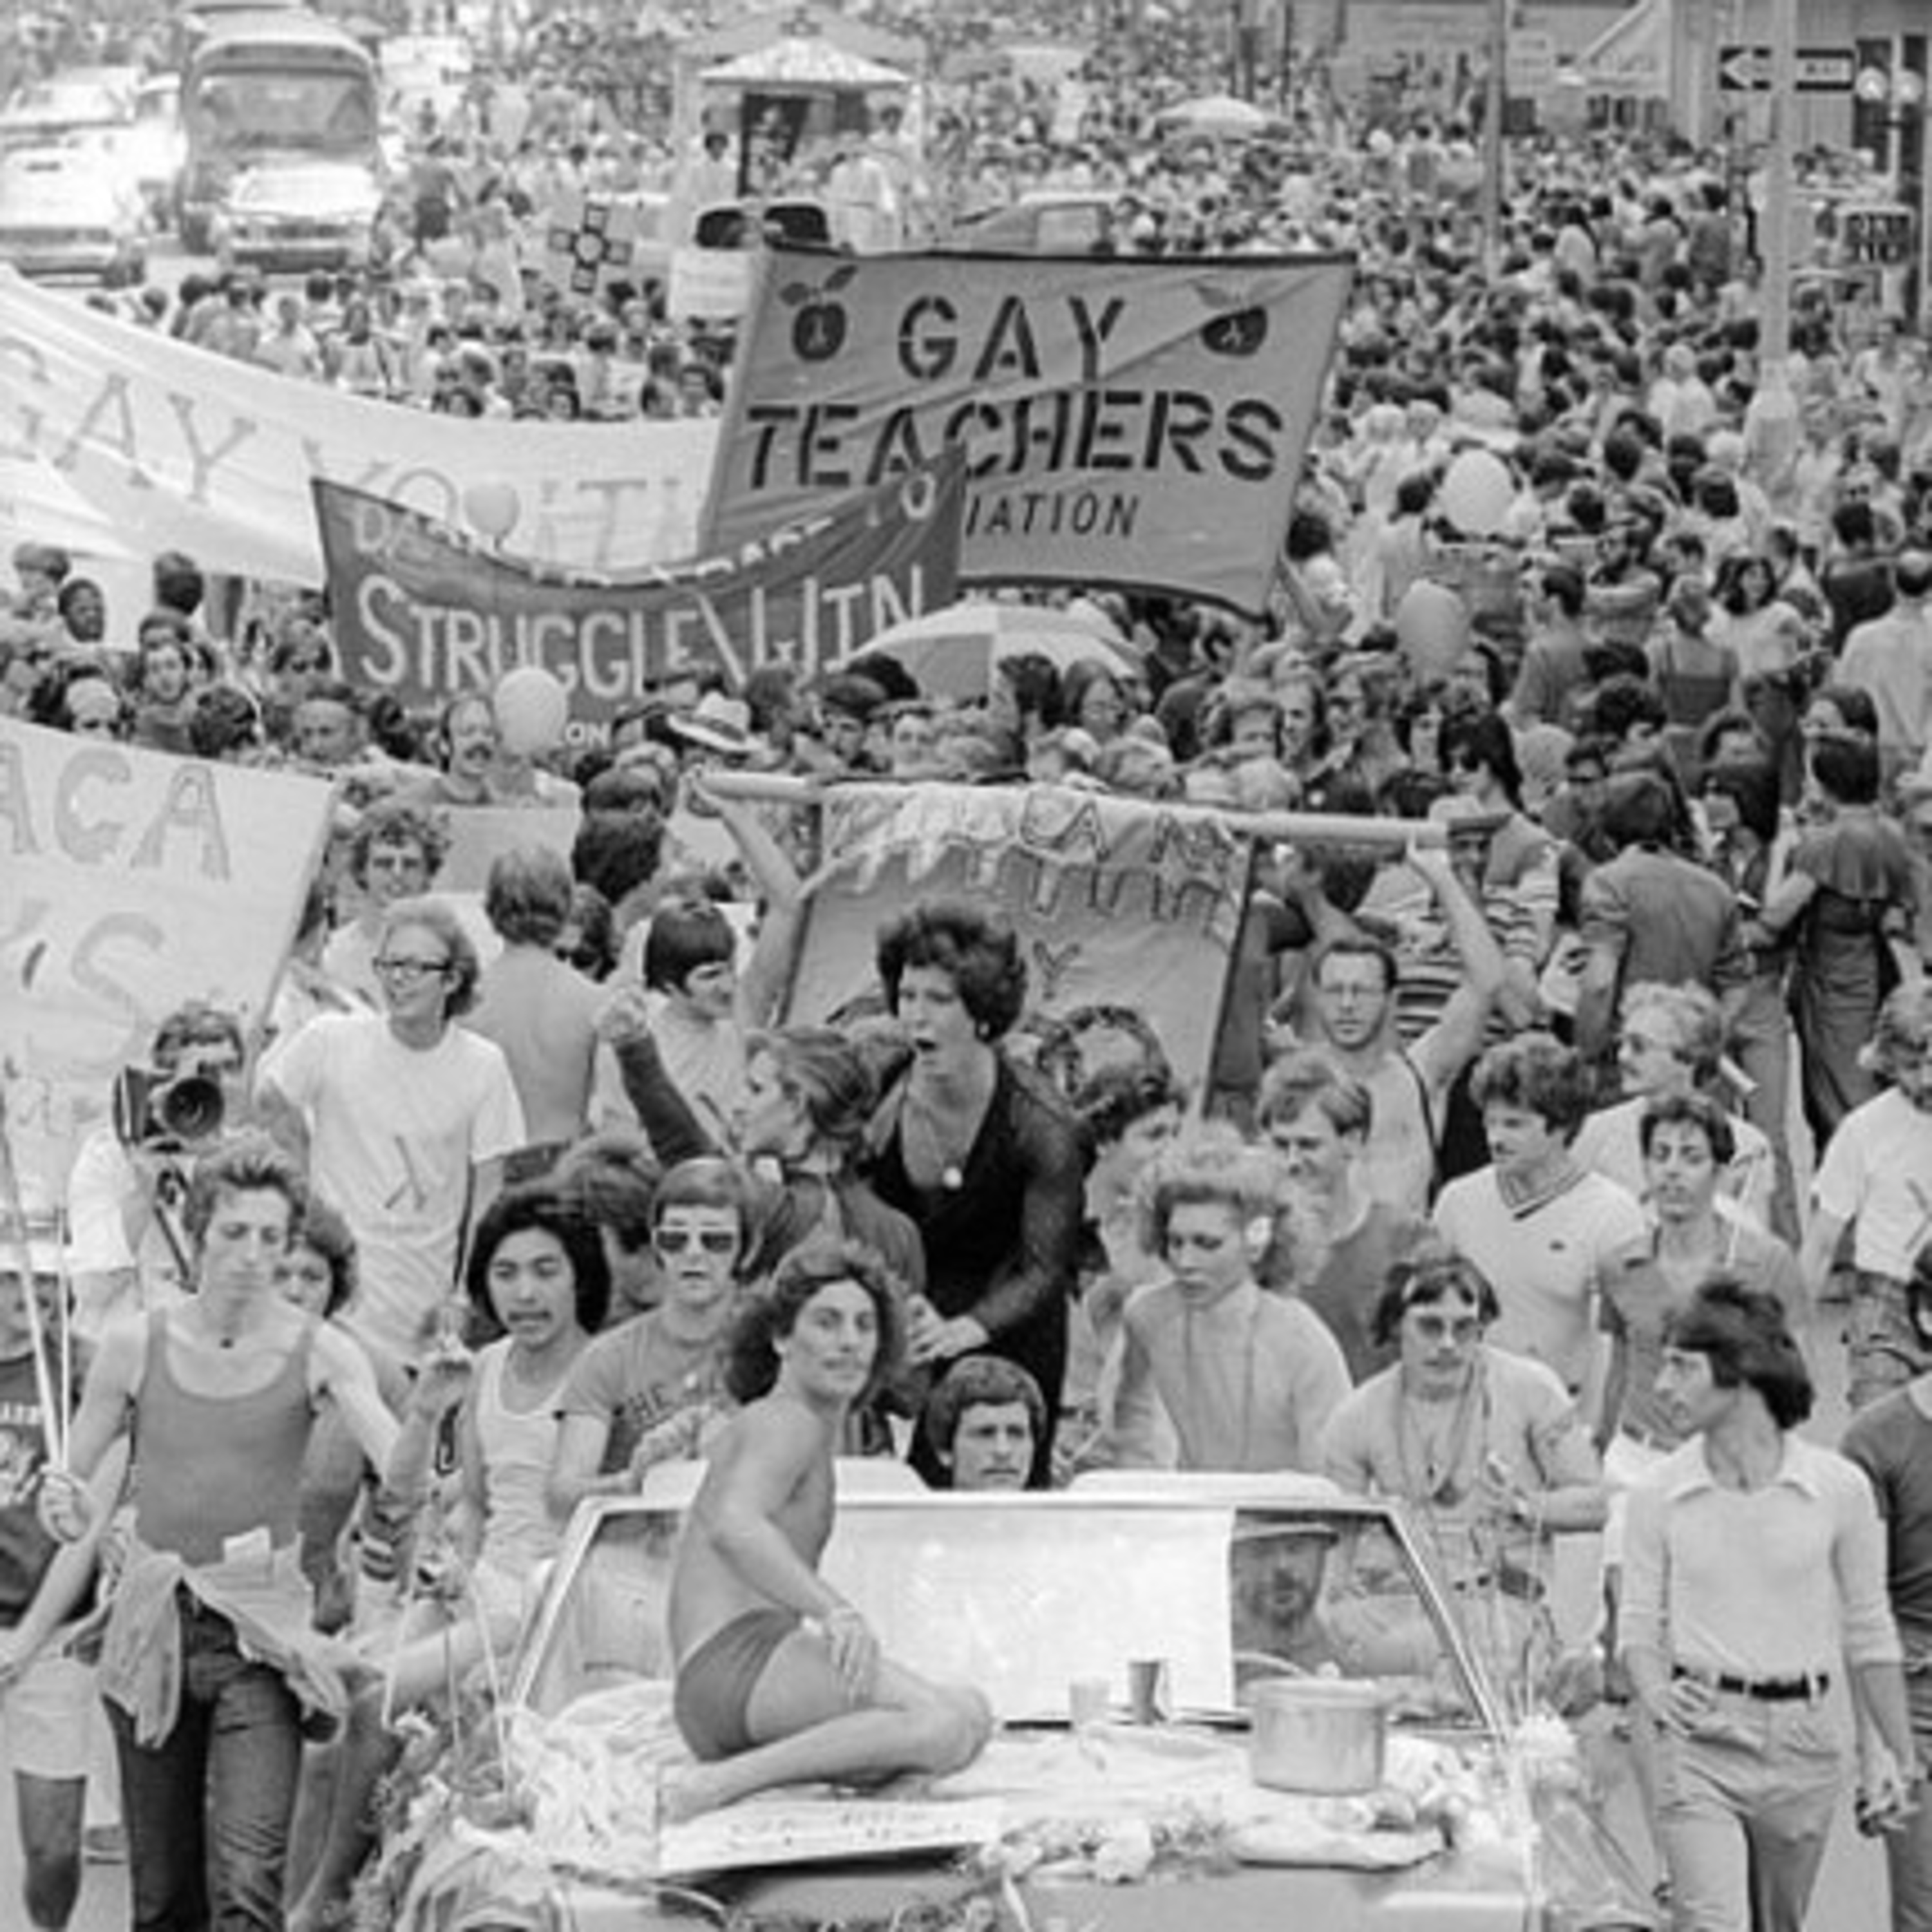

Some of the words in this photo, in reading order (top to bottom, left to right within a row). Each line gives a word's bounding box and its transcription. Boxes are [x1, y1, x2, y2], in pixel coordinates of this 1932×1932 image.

[898, 294, 1126, 381] GAY
[747, 390, 1283, 489] TEACHERS
[965, 490, 1139, 538] IATION
[358, 573, 699, 699] STRUGGLE
